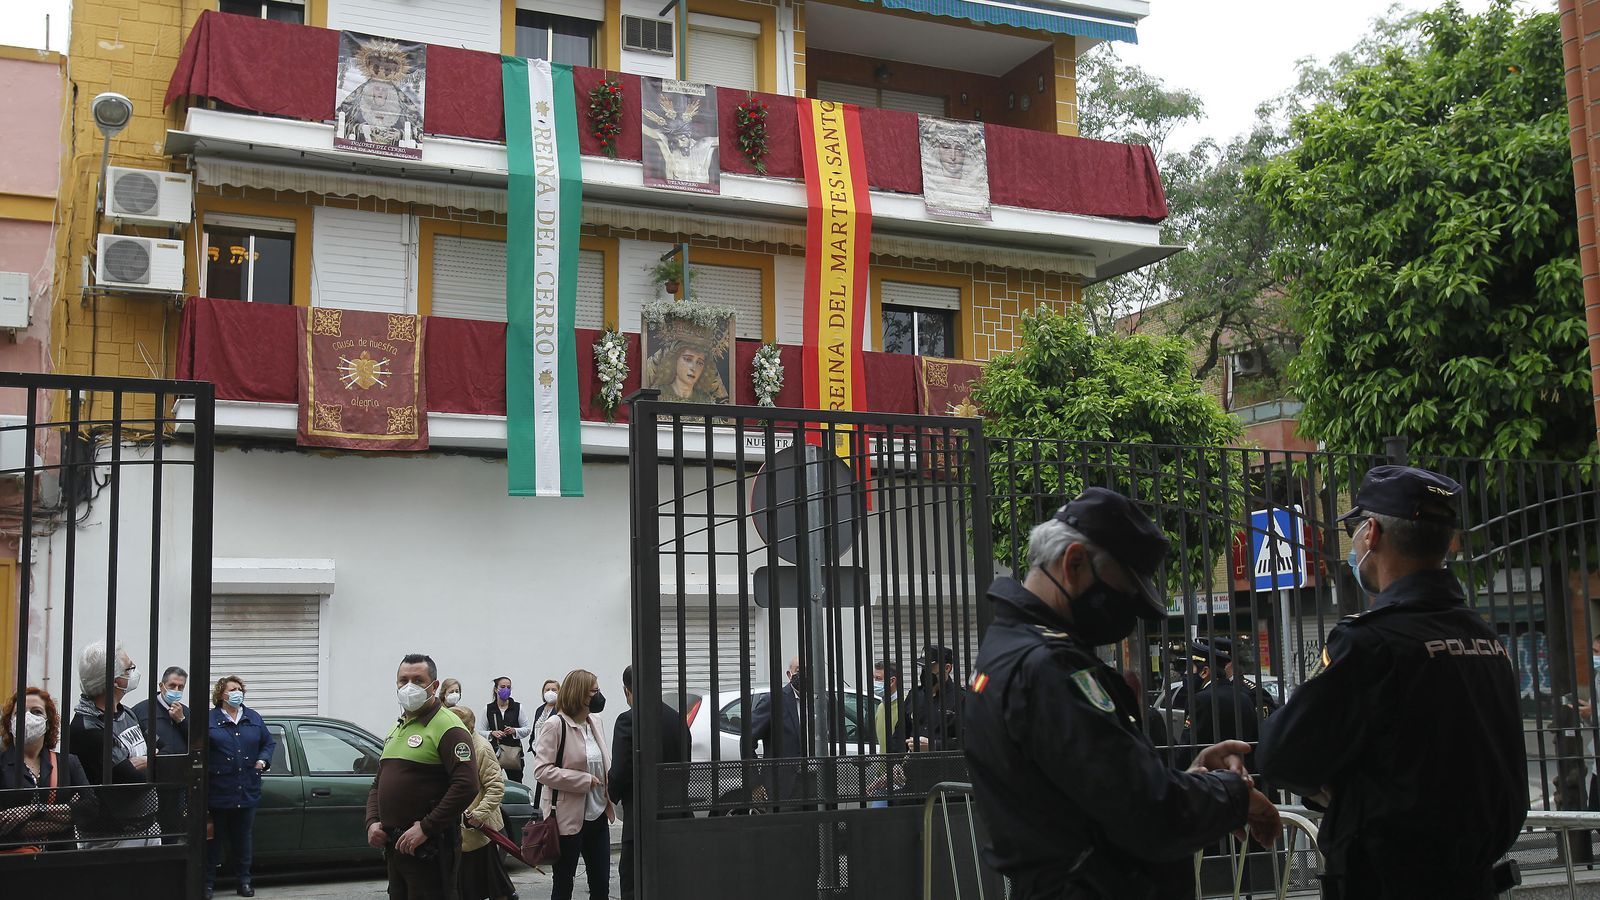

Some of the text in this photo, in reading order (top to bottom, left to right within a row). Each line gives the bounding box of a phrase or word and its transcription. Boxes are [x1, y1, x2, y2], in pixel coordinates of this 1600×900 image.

[534, 127, 556, 356] REINA DEL CERRO
[820, 100, 848, 411] REINA DEL MARTES SANTO
[332, 337, 398, 356] causa de nuestra
[350, 396, 380, 413] alegria
[1424, 638, 1506, 658] POLICIA
